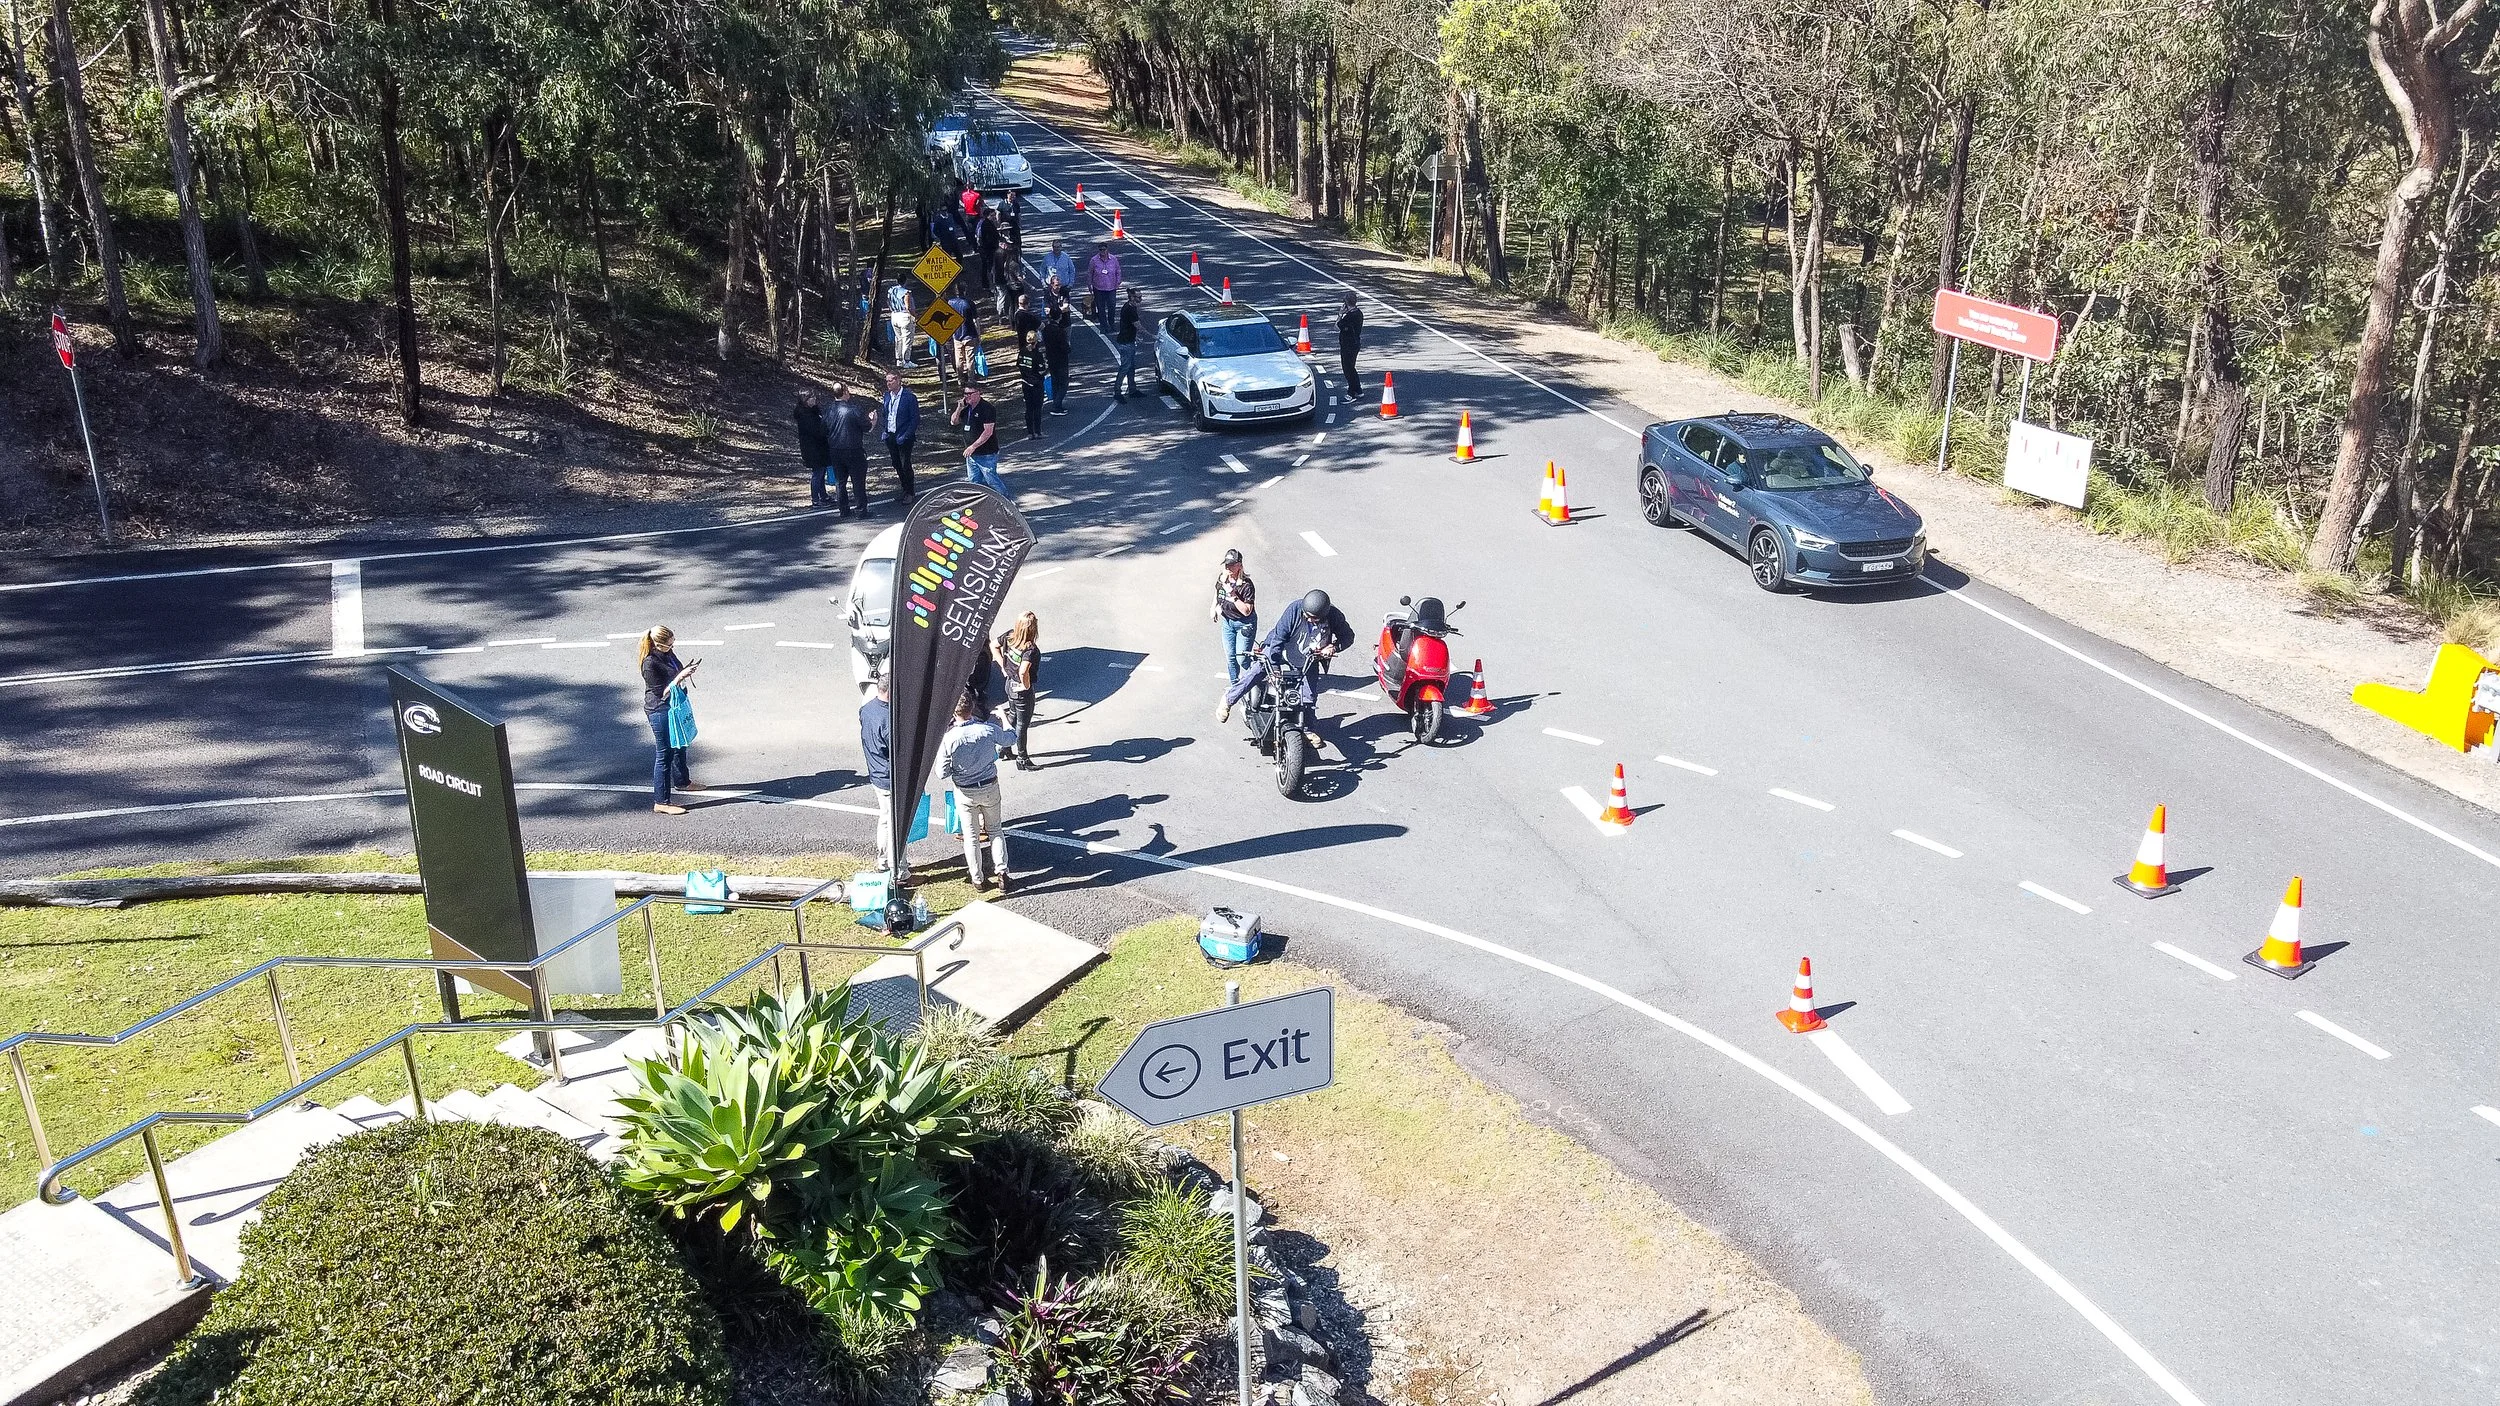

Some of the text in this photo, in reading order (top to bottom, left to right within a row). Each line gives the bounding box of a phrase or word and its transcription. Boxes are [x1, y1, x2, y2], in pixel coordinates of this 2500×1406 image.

[923, 270, 953, 280] WILDLIFE
[926, 256, 949, 265] WATCH
[54, 329, 71, 354] STOP
[942, 529, 1011, 642] SENSIUM
[962, 543, 1021, 649] FLEET TELEMATICS
[418, 764, 482, 797] ROAD CIRCUIT
[1222, 1027, 1311, 1081] Exit
